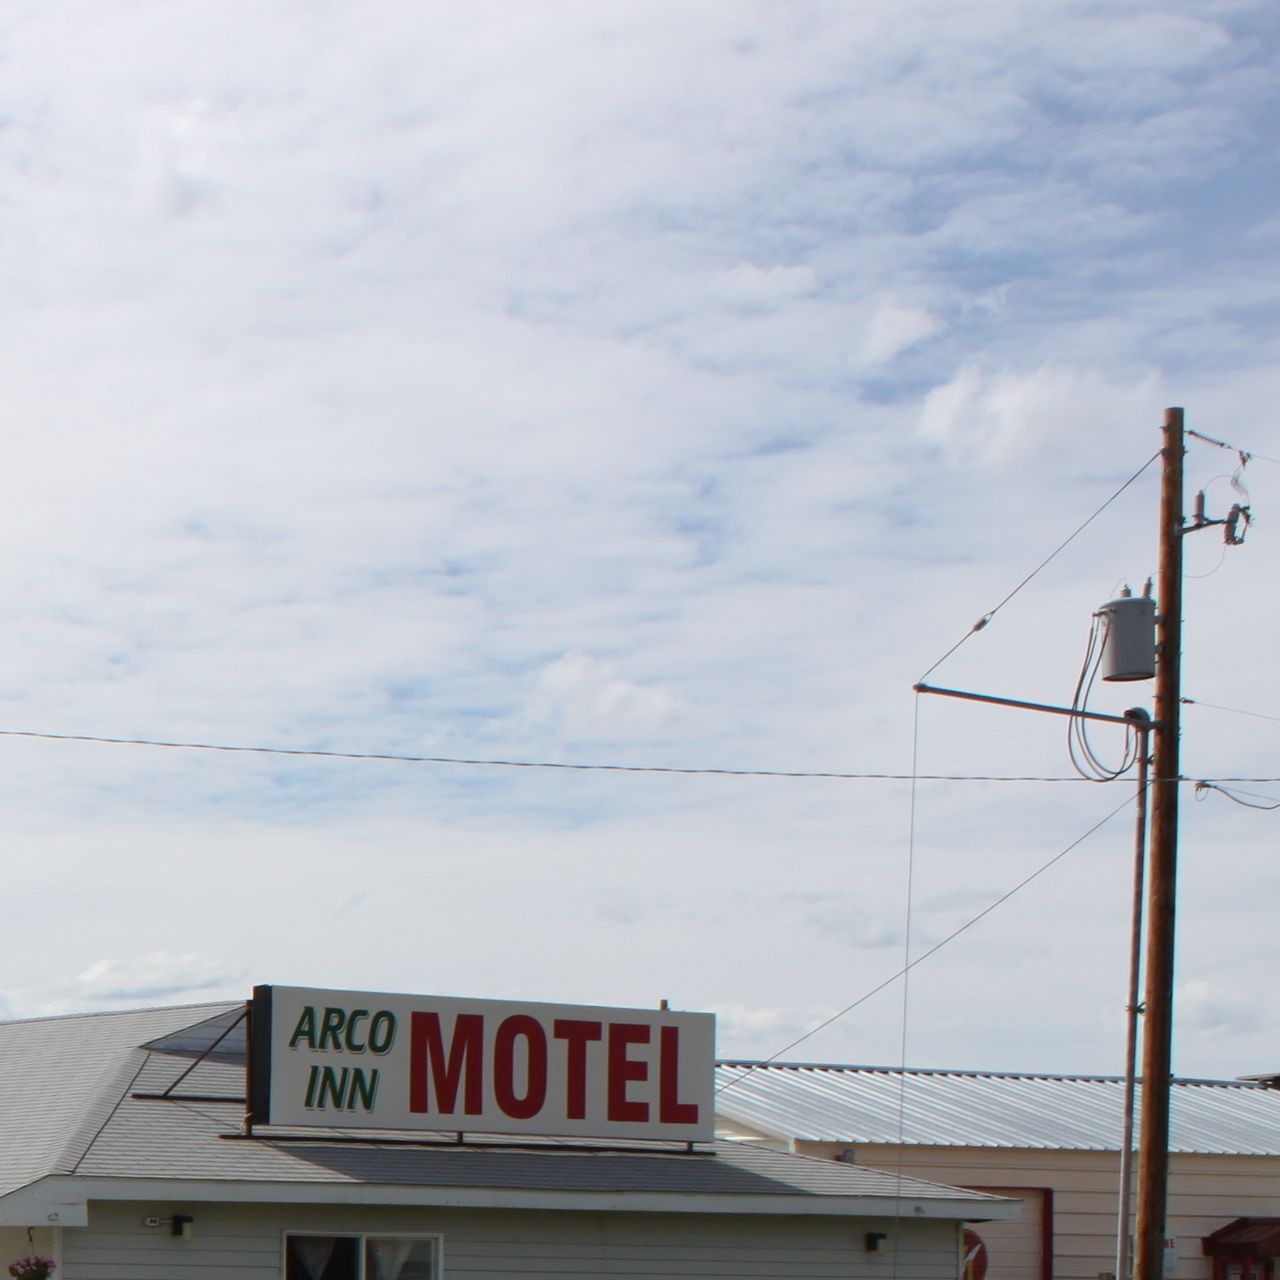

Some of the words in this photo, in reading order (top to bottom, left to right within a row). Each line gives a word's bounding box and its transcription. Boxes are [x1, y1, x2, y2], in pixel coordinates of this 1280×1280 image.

[289, 1006, 397, 1056] ARCO
[303, 1065, 380, 1113] INN
[409, 1010, 699, 1125] MOTEL
